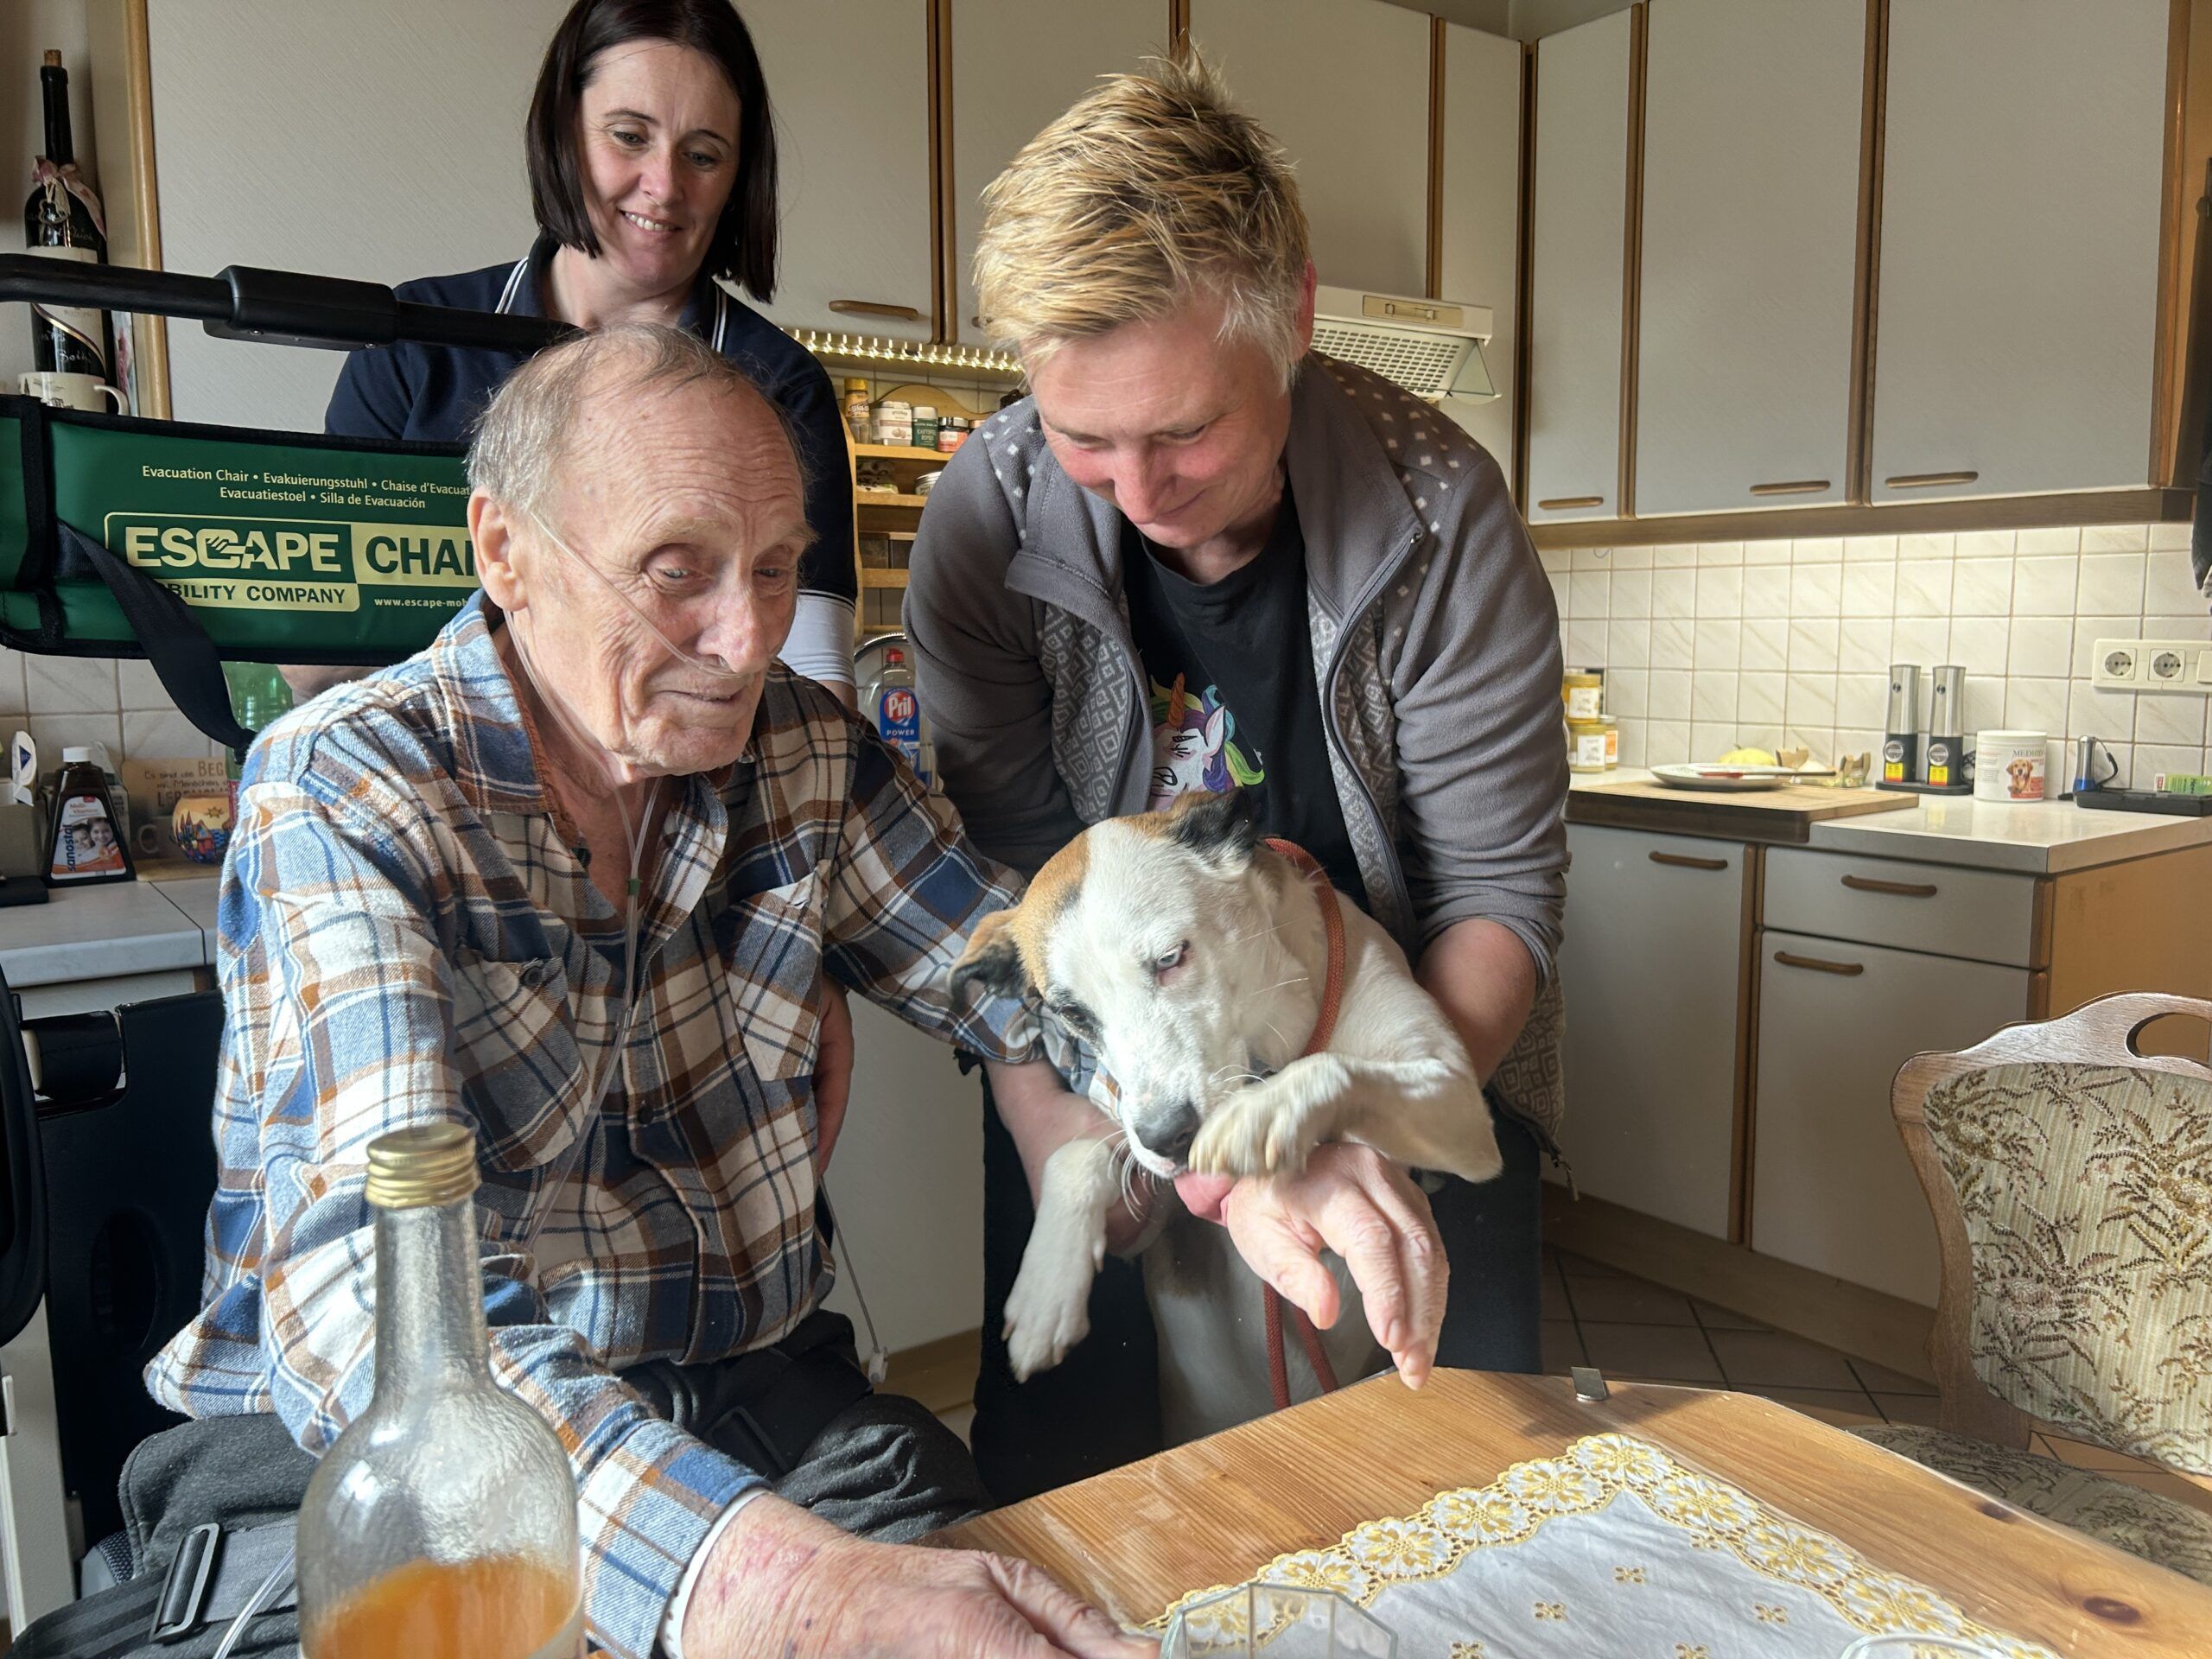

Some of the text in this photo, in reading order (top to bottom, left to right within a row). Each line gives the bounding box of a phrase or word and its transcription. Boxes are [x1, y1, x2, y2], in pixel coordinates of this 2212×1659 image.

[143, 465, 212, 480] Evacuation
[216, 469, 249, 482] Chair
[264, 472, 367, 490] Evakuierungsstuhl
[381, 480, 417, 493] Chaise
[220, 486, 426, 509] Evacuatiestoel Silla de Evacuación
[125, 526, 342, 572] ESCAPE
[167, 583, 346, 603] BILITY COMPANY
[888, 696, 912, 719] Pril
[62, 824, 76, 872] sanostol
